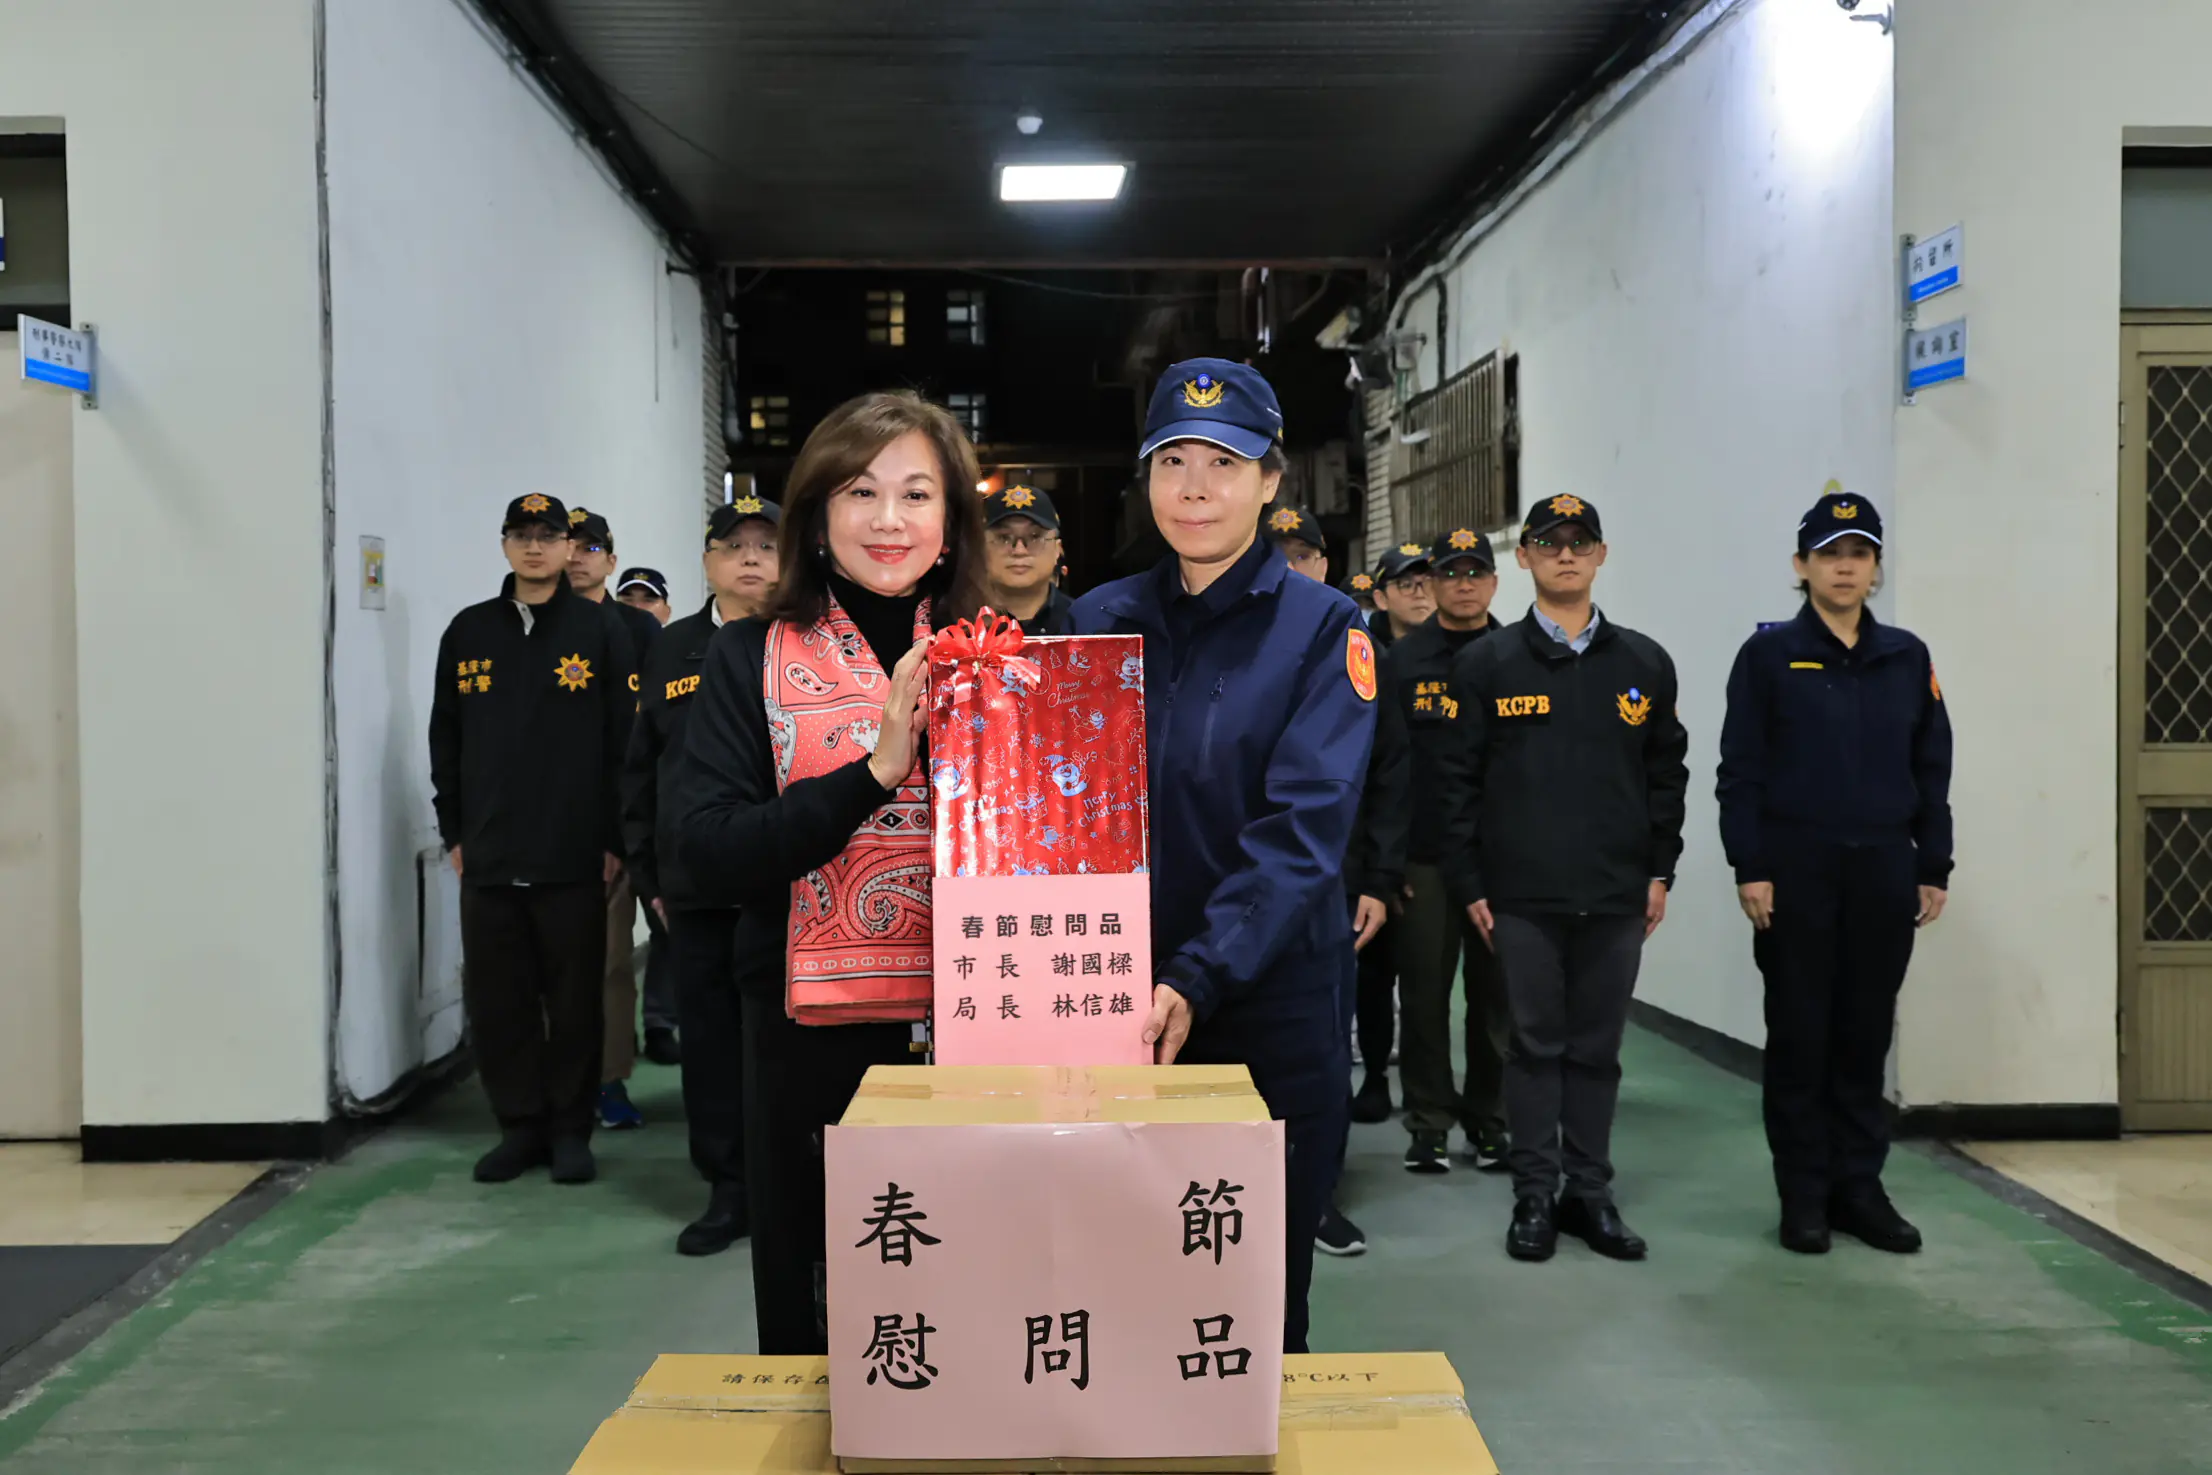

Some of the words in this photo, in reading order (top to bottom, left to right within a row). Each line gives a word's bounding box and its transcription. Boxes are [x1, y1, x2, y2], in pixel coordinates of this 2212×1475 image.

[665, 674, 701, 700] KCP
[1495, 694, 1551, 717] KCPB
[1083, 790, 1117, 810] Merry
[1078, 801, 1133, 828] Christmas
[961, 913, 1122, 939] 春節慰問品
[1051, 951, 1133, 977] 謝國樑
[1052, 991, 1134, 1018] 林信雄
